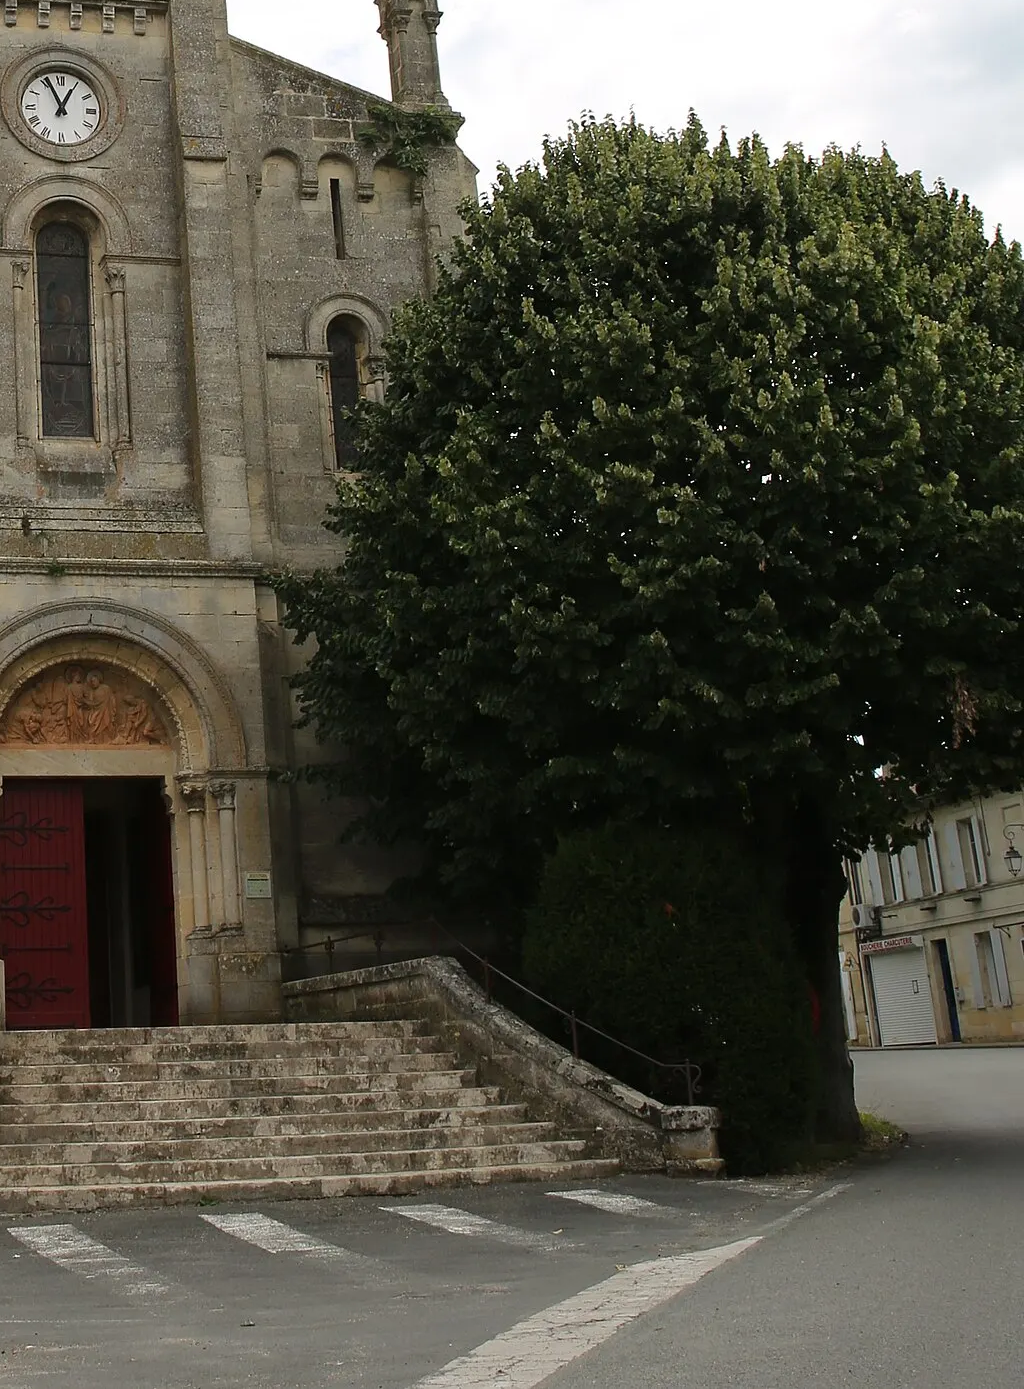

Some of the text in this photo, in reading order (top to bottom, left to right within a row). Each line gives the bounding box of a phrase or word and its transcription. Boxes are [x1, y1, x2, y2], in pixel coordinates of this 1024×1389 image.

[81, 93, 92, 101] II
[28, 114, 41, 128] VIII
[40, 126, 51, 138] VII
[58, 132, 65, 142] VI
[861, 936, 913, 951] BOUCHERIE CHARCUTERIE
